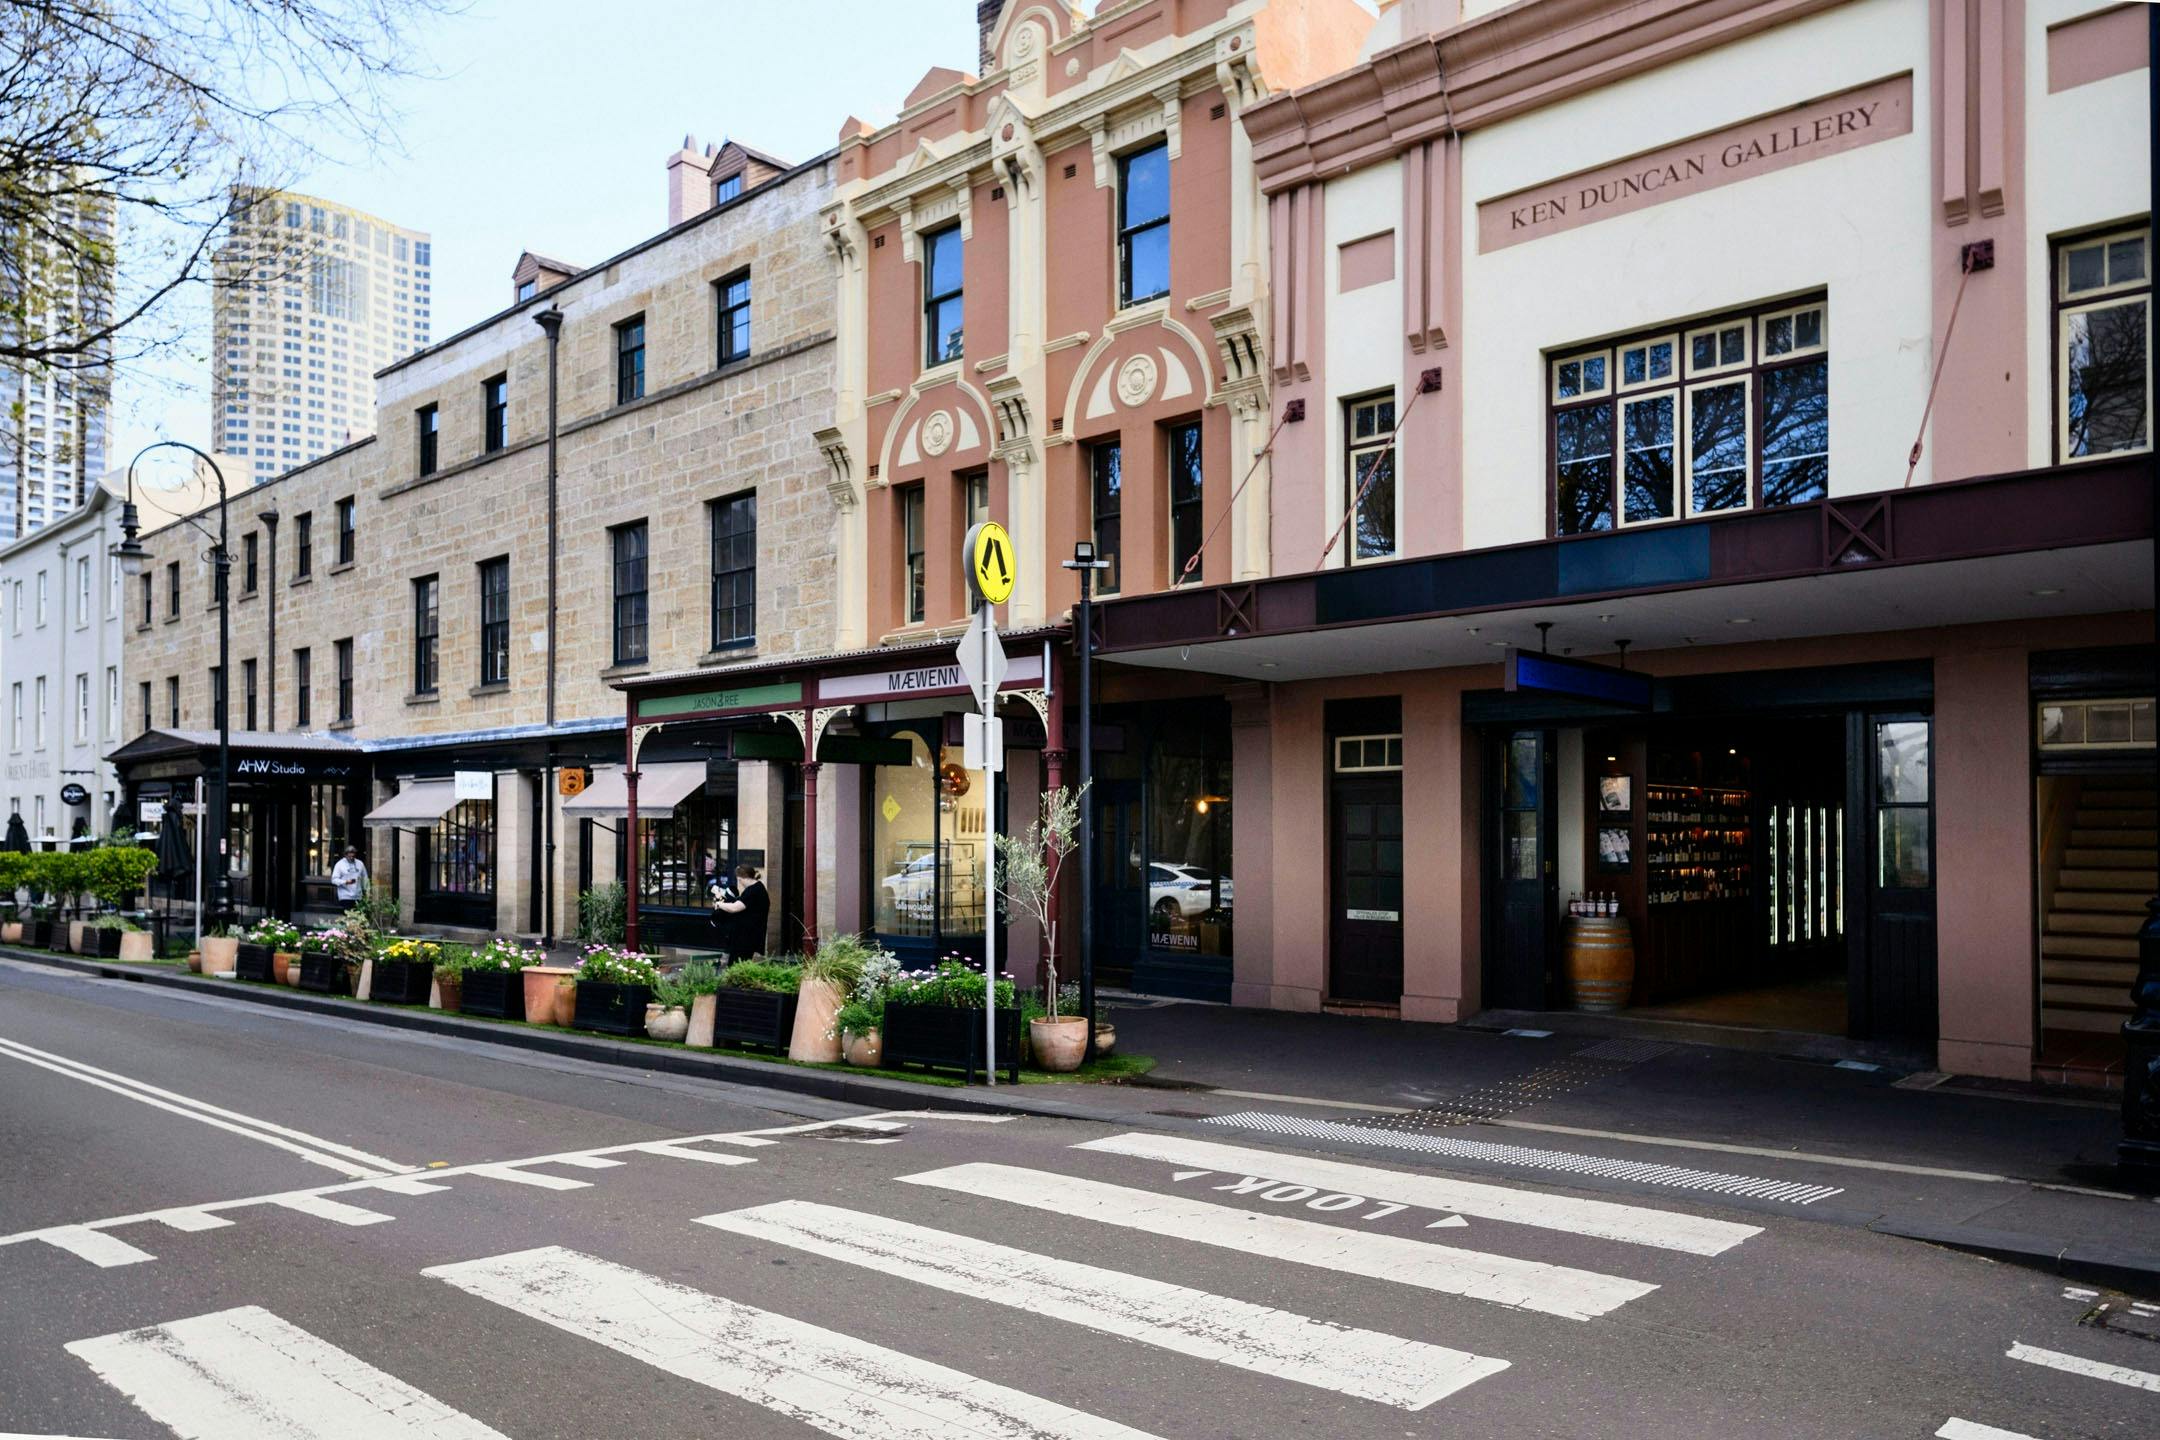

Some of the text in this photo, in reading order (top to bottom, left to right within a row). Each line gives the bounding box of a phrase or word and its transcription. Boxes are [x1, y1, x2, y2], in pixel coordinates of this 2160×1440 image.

[1511, 102, 1880, 230] KEN DUNCAN GALLERY
[888, 666, 959, 690] MÆWENN
[237, 759, 306, 775] AHW Studio
[1151, 932, 1198, 947] MÆWENN
[1211, 1176, 1410, 1220] LOOK
